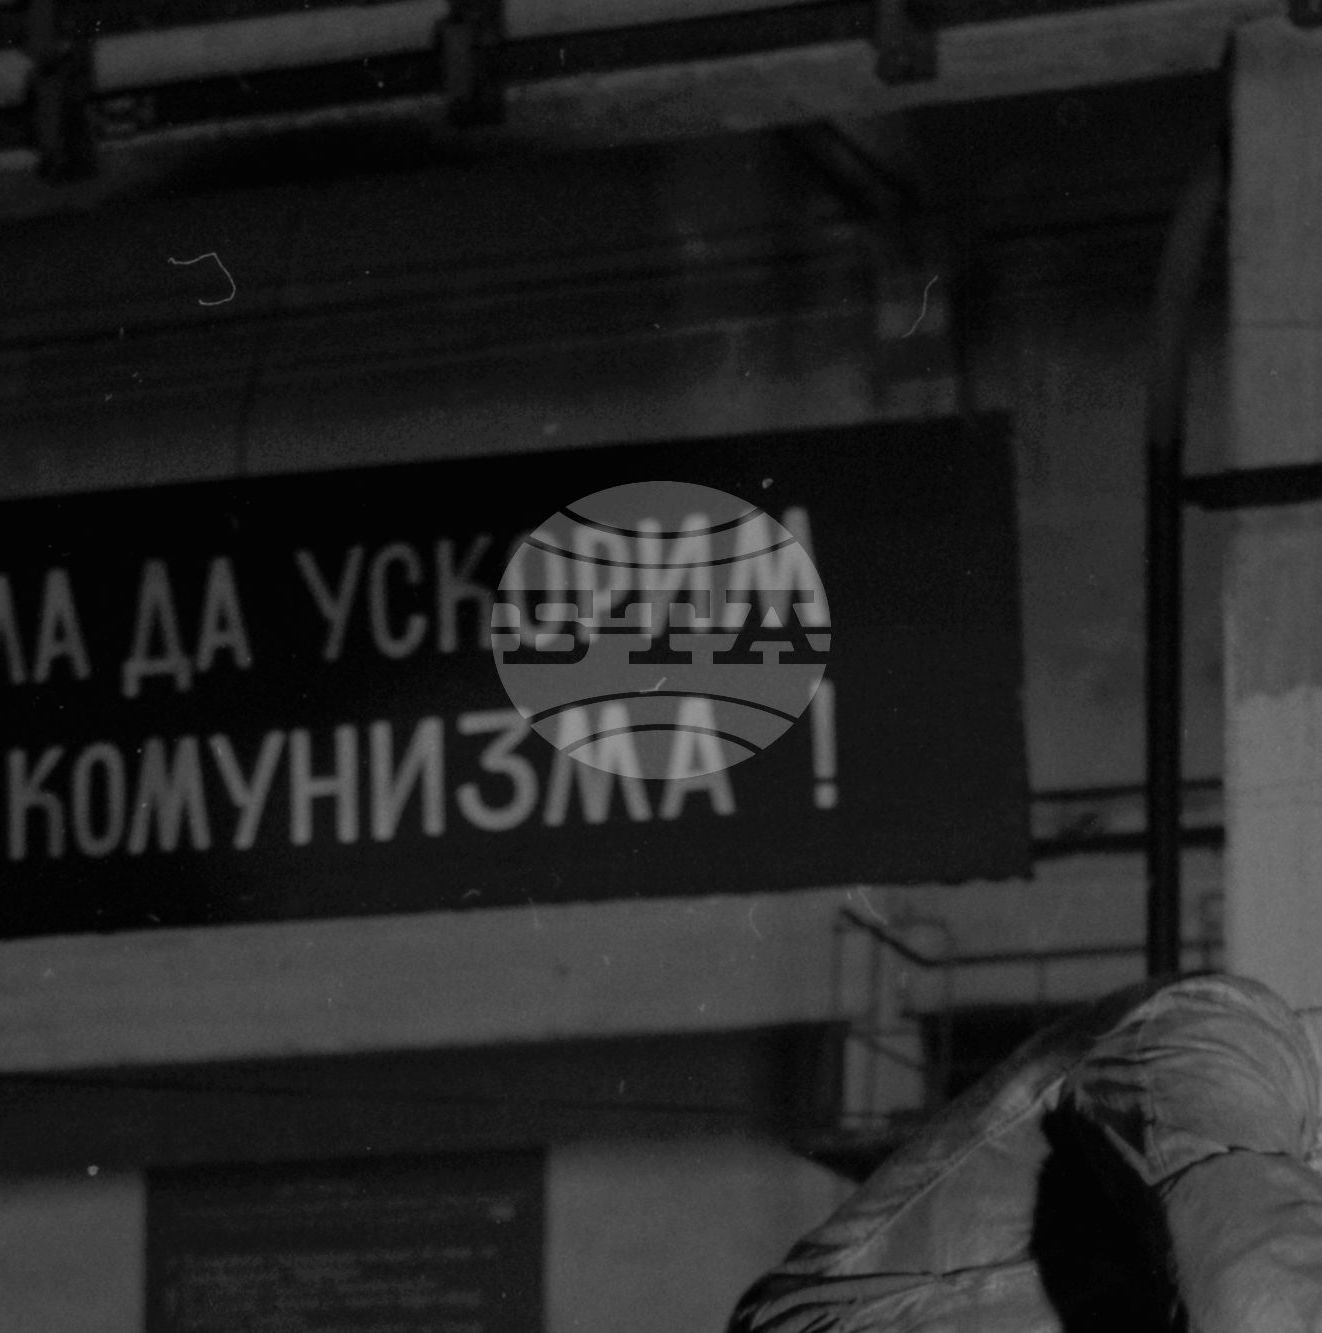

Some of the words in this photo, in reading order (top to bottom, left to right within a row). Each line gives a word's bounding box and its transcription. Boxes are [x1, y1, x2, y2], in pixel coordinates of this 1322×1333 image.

[121, 555, 253, 699] ДА
[292, 506, 829, 663] УСКОРИМ
[5, 695, 738, 862] КОМУНИЗМА
